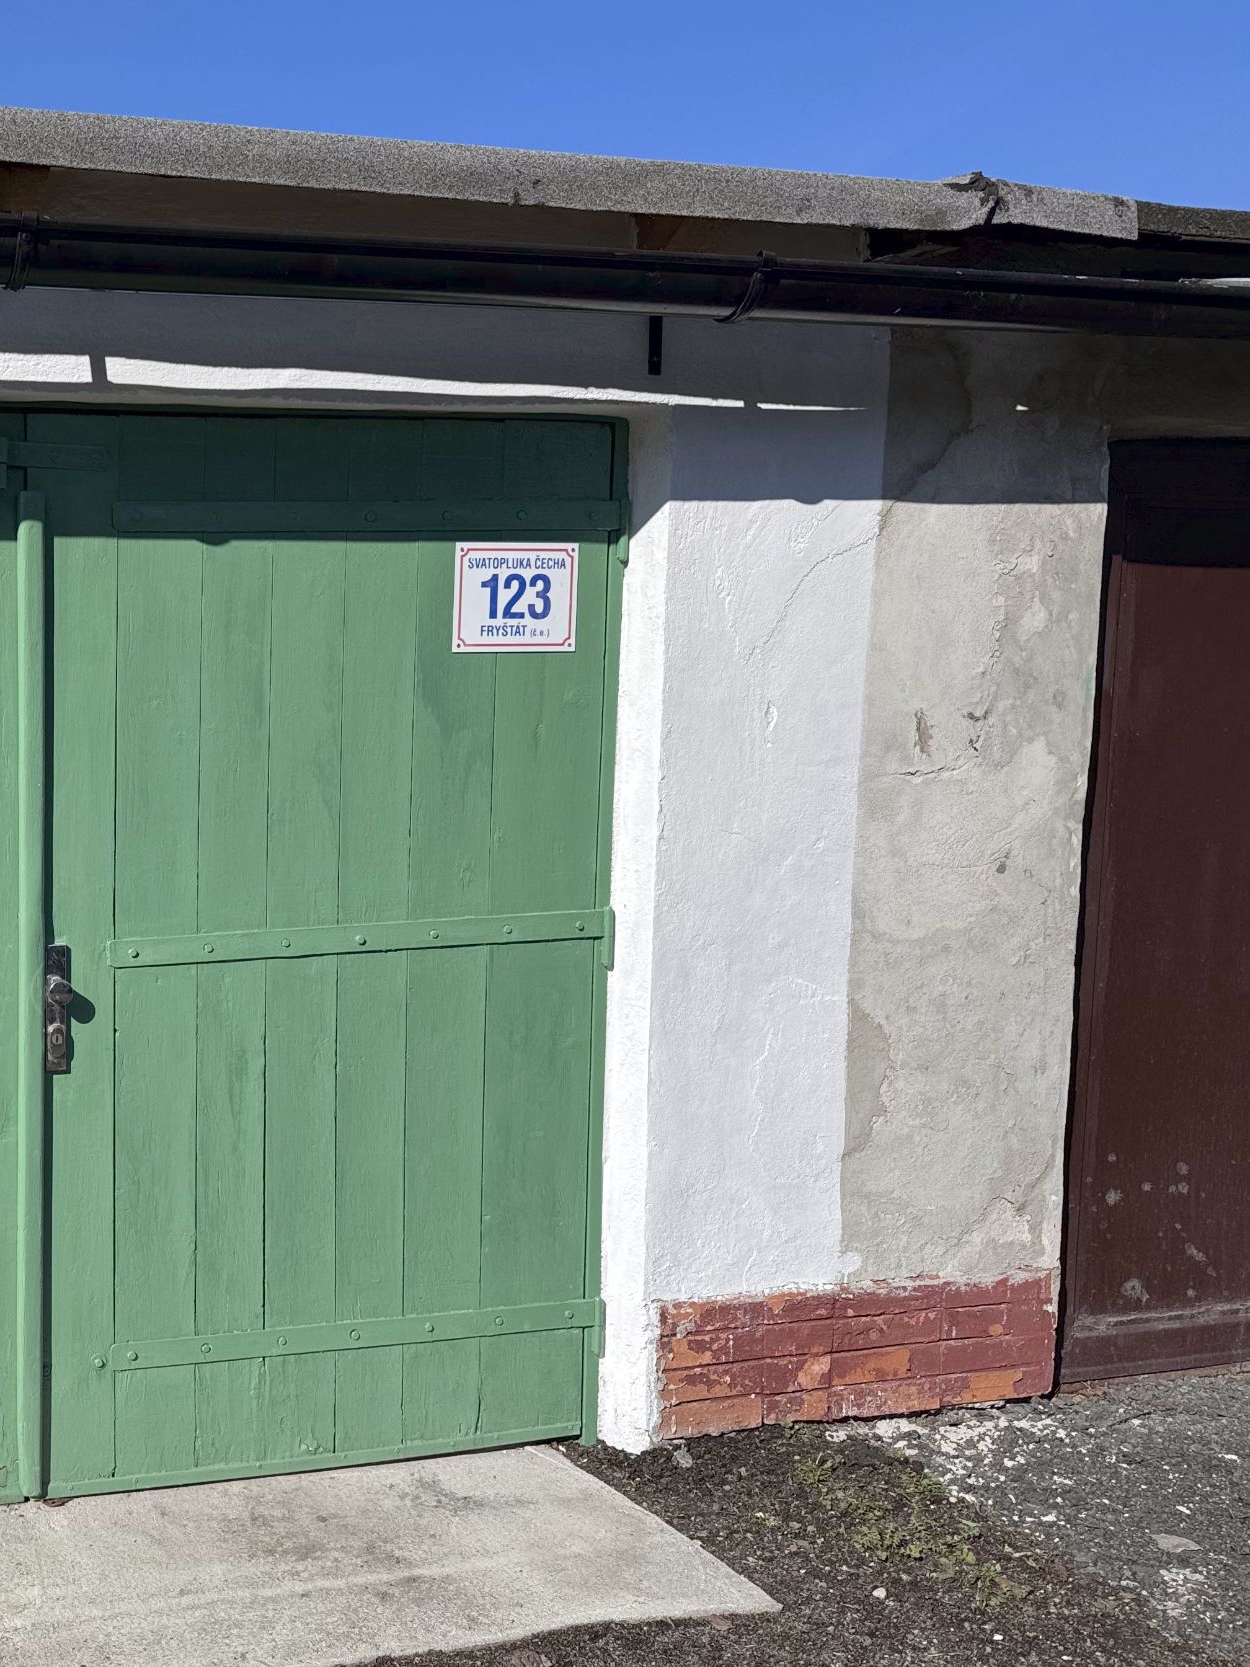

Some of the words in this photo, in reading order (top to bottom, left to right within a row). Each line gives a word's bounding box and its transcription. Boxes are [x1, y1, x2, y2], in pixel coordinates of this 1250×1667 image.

[467, 557, 532, 570] SVATOPLUKA
[534, 554, 566, 570] ČECHA
[480, 573, 552, 620] 123
[480, 622, 528, 637] FRYŠTÁT
